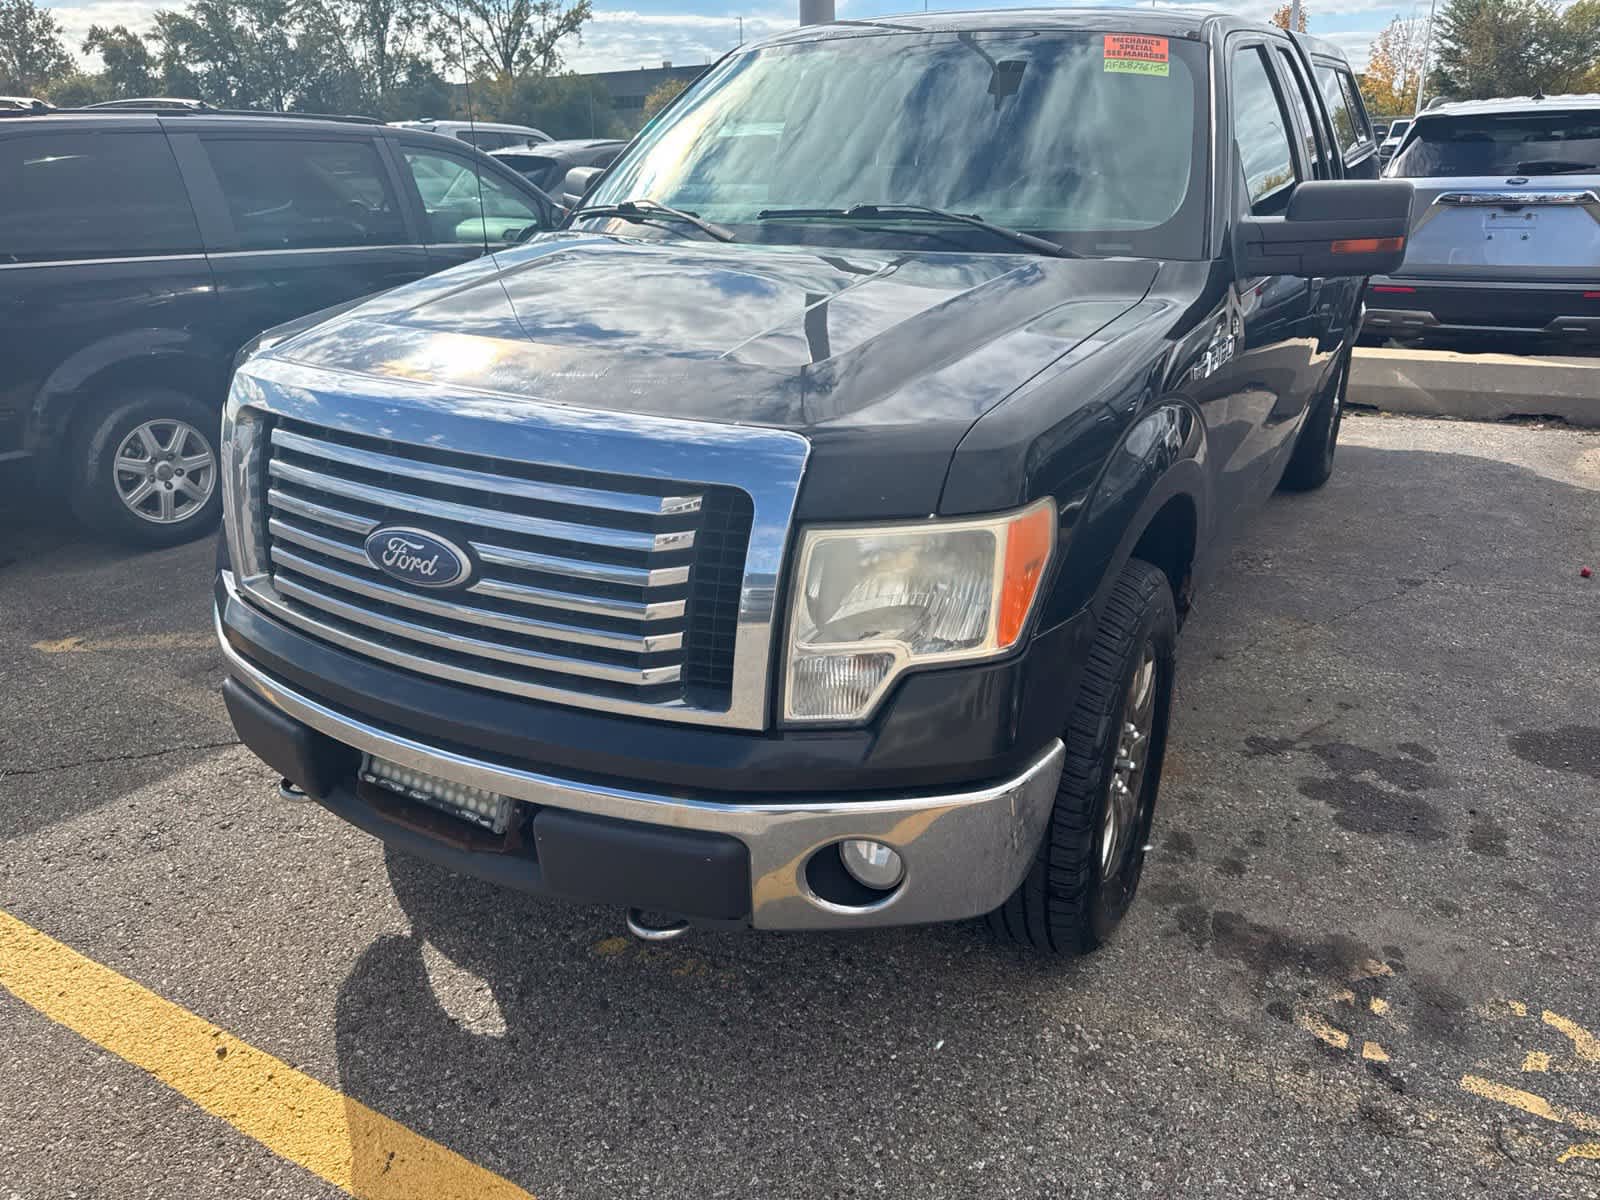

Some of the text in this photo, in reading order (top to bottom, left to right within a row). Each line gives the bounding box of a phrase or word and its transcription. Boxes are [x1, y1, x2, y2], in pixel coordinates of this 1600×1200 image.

[1112, 37, 1161, 46] MECHANICS
[1119, 44, 1153, 52] SPECIAL
[1123, 51, 1166, 59] MANAGER
[382, 537, 439, 576] Ford
